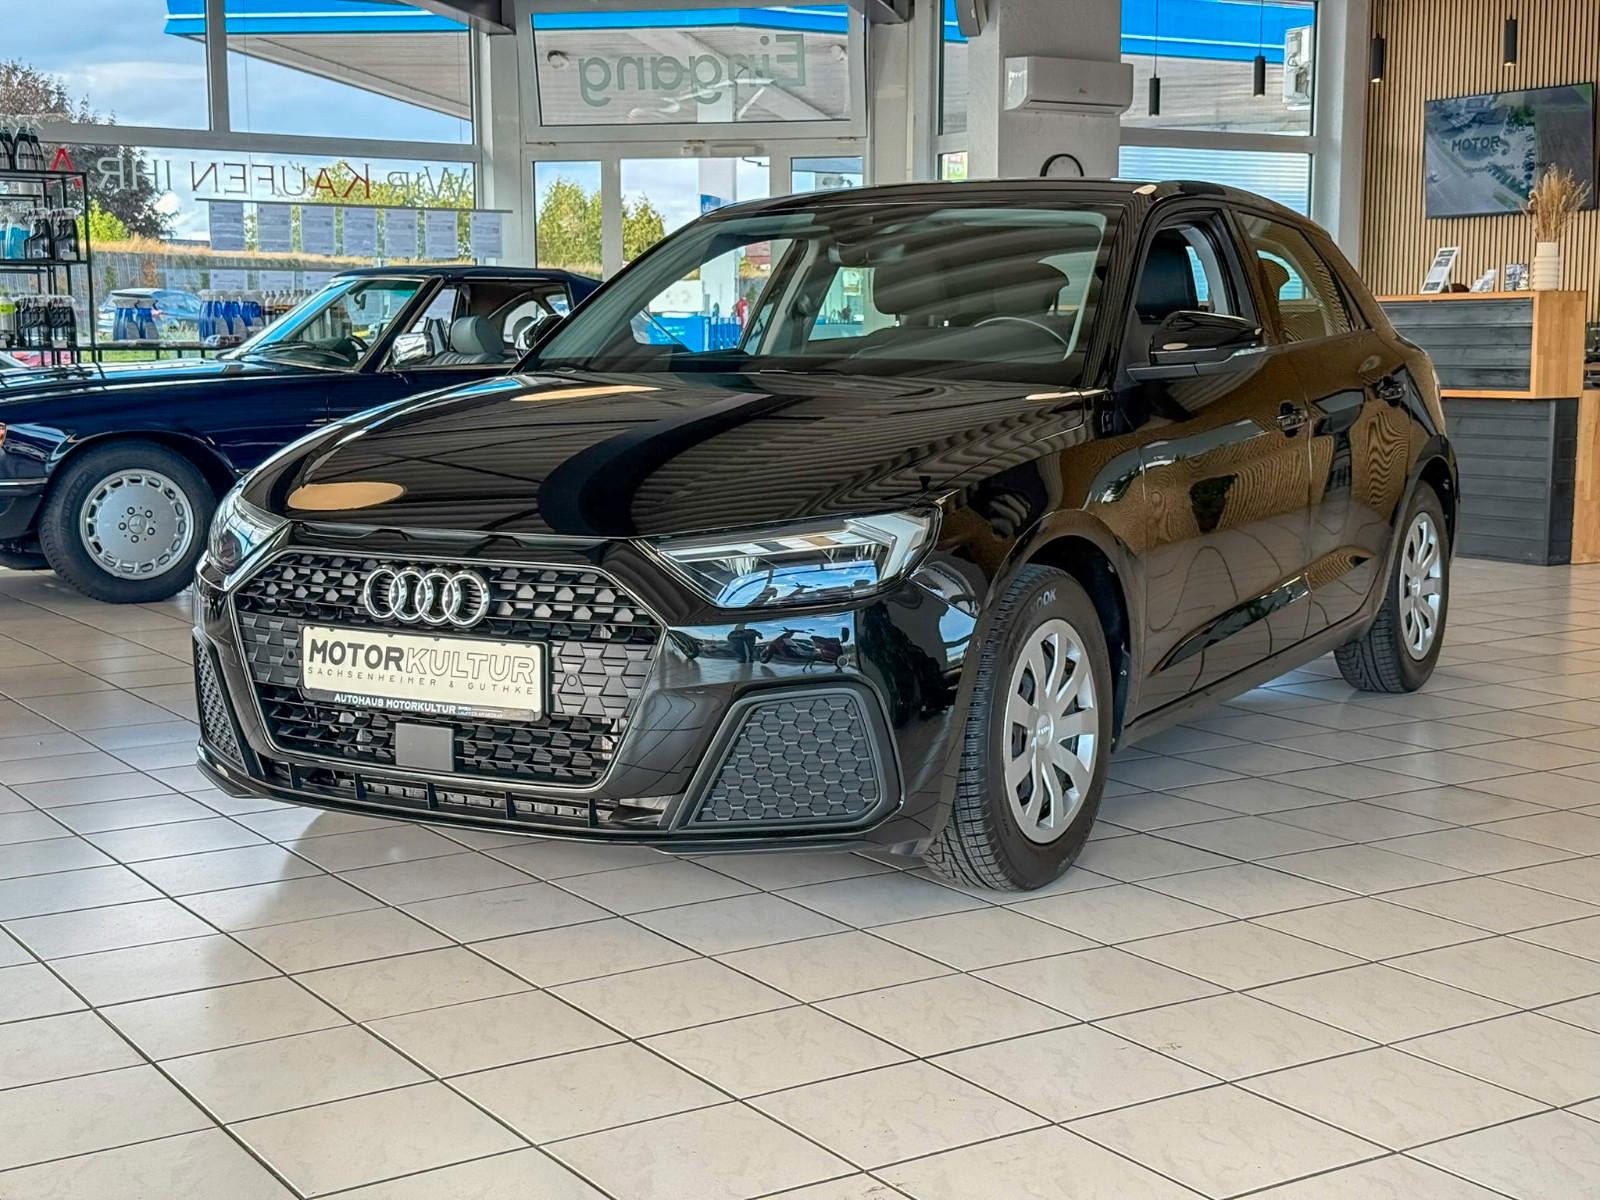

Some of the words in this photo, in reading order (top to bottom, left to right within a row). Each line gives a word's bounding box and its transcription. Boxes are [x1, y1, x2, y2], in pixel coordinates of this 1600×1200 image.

[308, 638, 535, 684] MOTORKULTUR
[308, 666, 436, 687] SACHSENHEIMER
[449, 680, 455, 688] &
[468, 682, 533, 695] GUTHKE
[334, 693, 384, 707] AUTOHAUS
[386, 699, 456, 715] MOTORKULTUR
